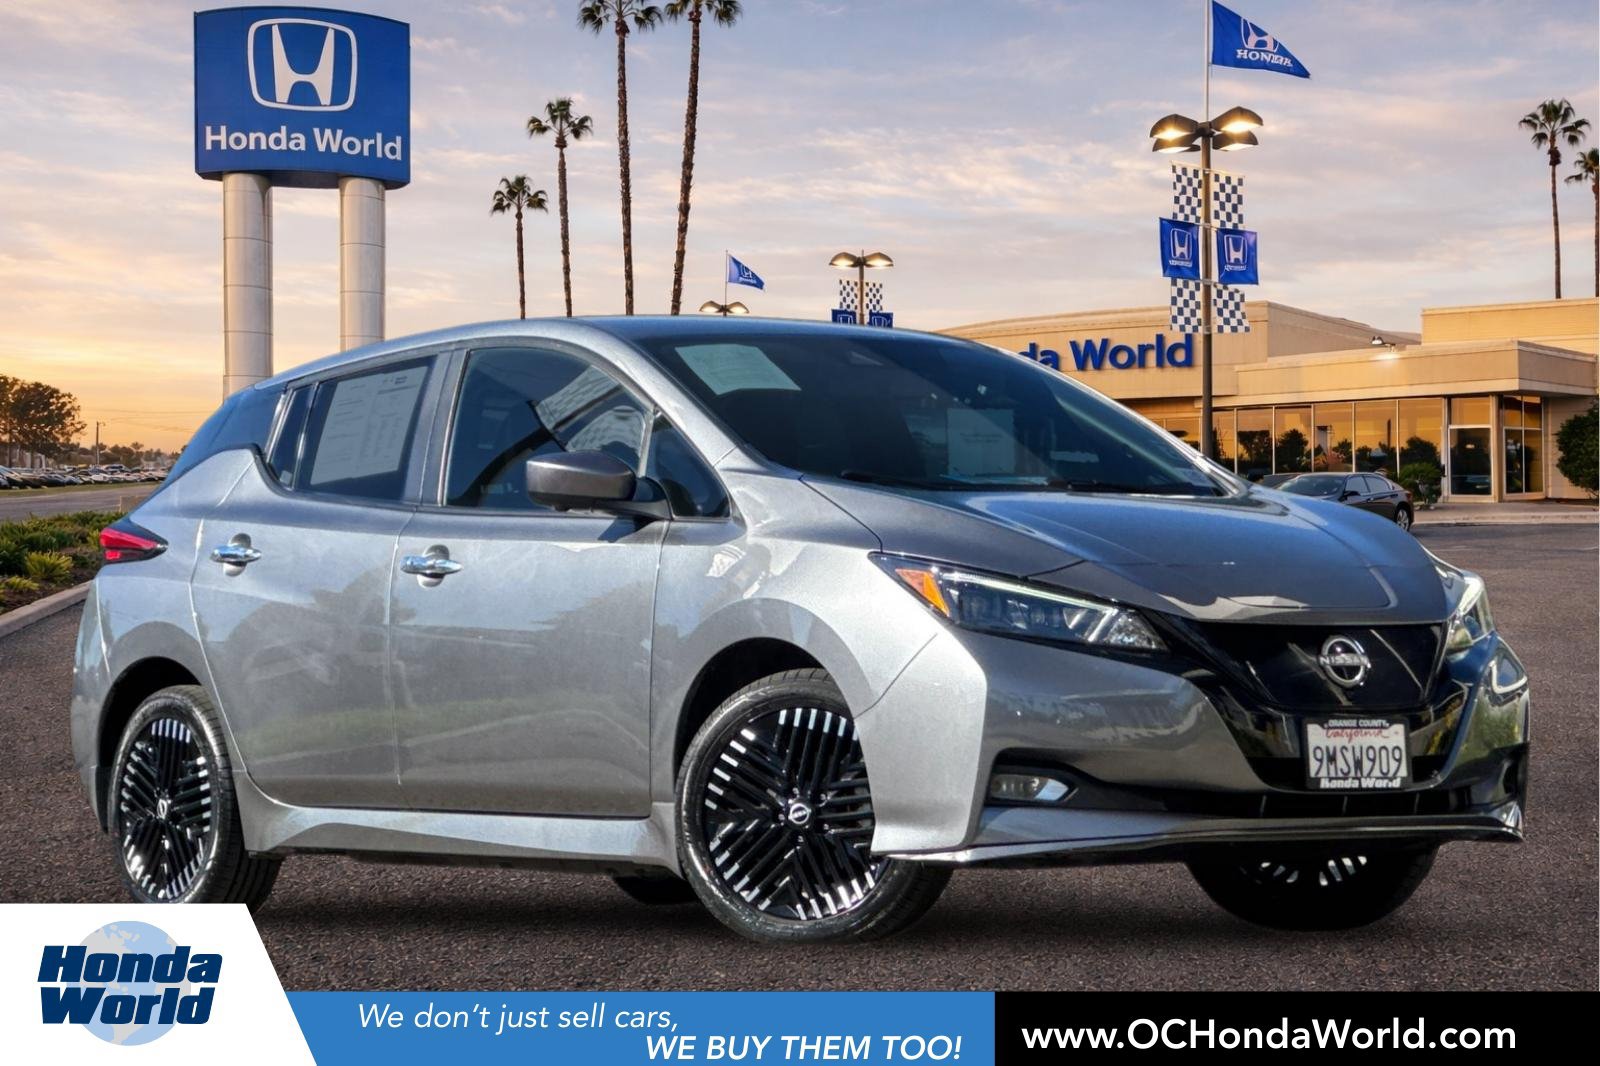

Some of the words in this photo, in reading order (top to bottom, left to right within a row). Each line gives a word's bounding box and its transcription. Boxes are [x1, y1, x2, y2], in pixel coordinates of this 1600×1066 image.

[205, 125, 306, 151] Honda
[313, 127, 402, 161] World
[1069, 333, 1194, 371] World
[1319, 655, 1369, 667] NISSAN
[1328, 719, 1357, 728] ORANGE
[1358, 719, 1387, 728] COUNTY
[1325, 728, 1390, 744] California
[1312, 745, 1402, 777] 9MSW909
